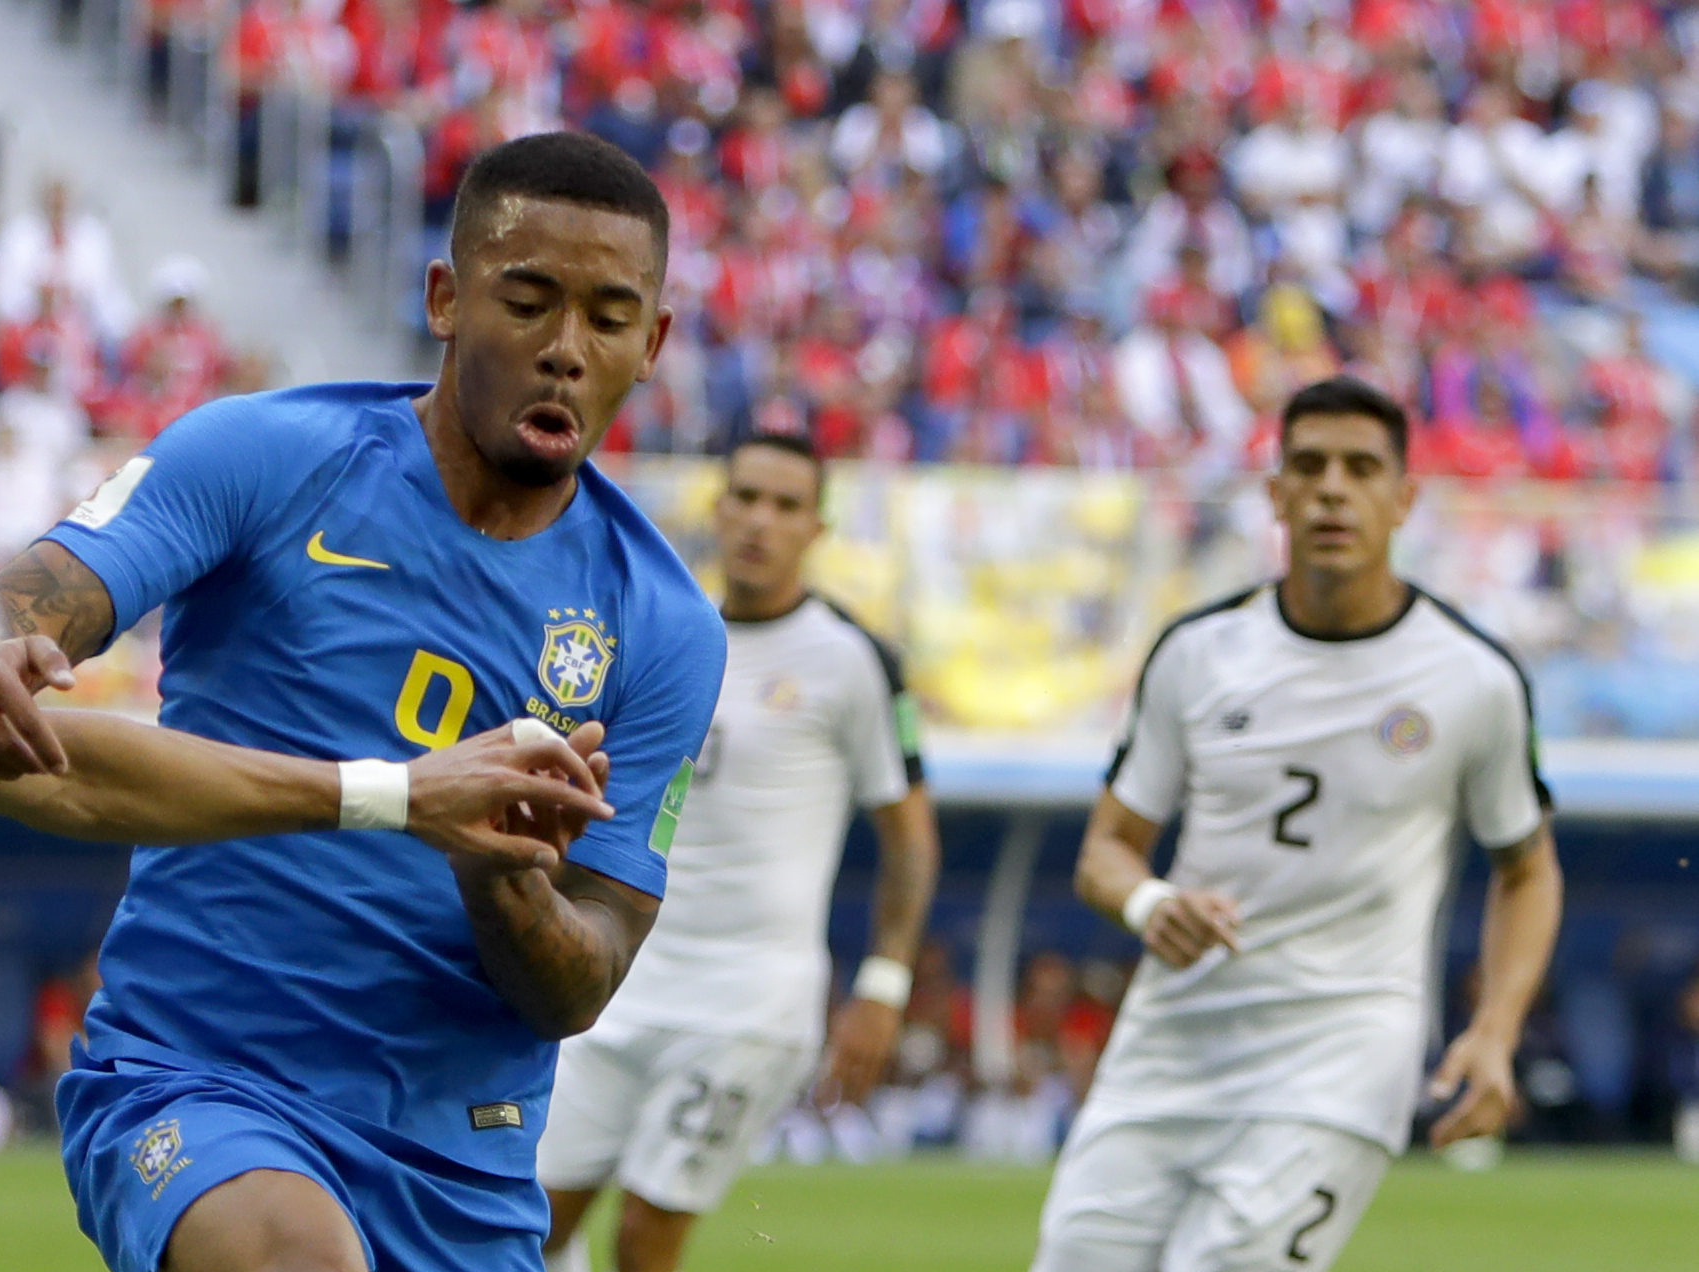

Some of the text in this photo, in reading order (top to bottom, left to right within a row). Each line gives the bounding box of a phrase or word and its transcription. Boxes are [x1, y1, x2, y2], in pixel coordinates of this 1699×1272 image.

[395, 649, 475, 752] 9
[563, 654, 587, 670] CBF
[1273, 763, 1321, 850] 2
[667, 1069, 748, 1148] 20
[151, 1156, 193, 1201] BRASIL
[1284, 1184, 1336, 1262] 2
